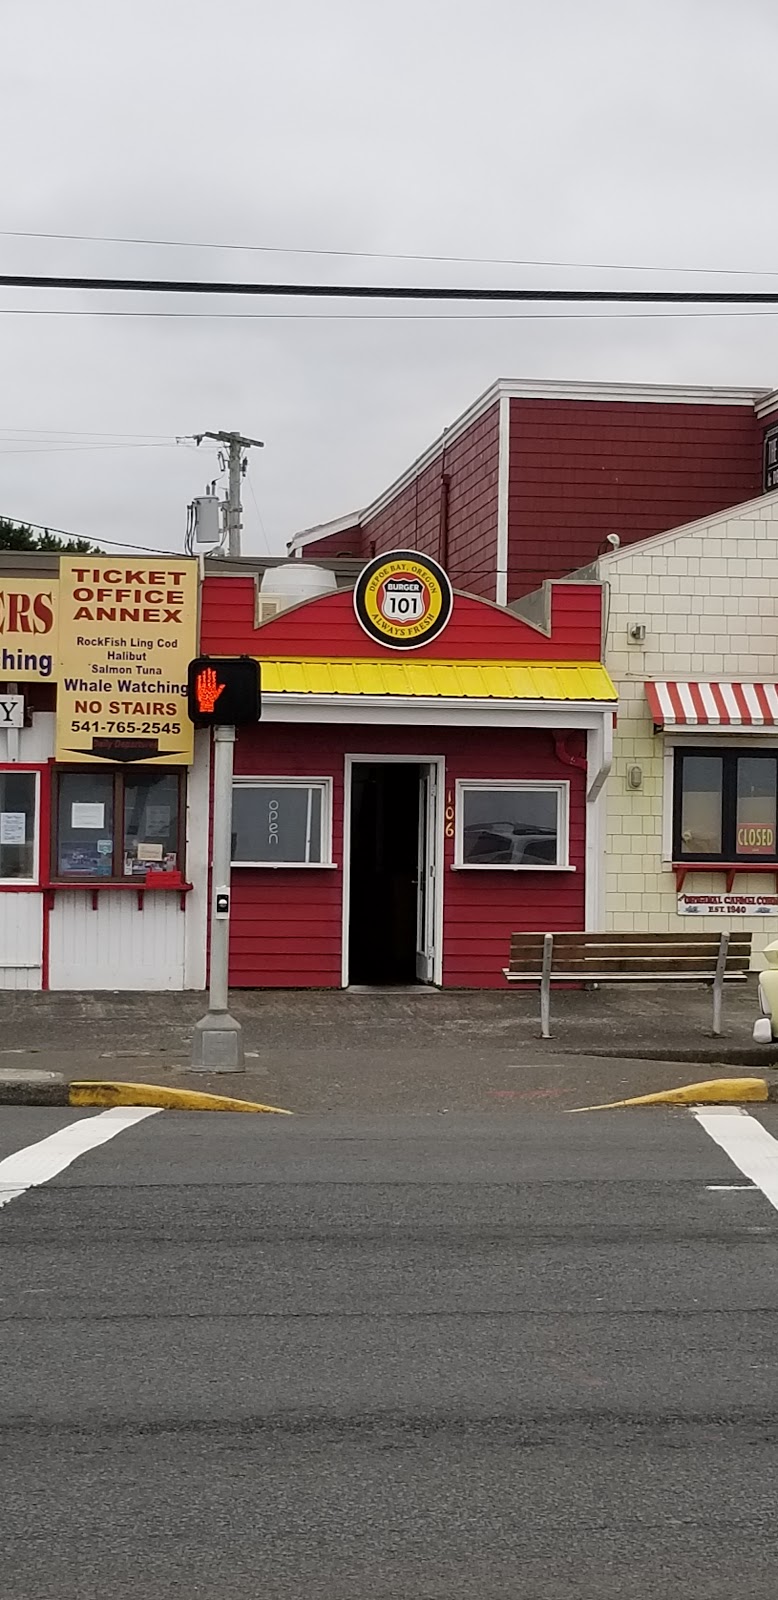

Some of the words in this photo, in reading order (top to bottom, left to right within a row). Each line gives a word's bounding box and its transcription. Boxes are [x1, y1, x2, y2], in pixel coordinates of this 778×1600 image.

[71, 568, 187, 586] TICKET
[369, 569, 390, 592] DEPOE
[411, 566, 438, 594] OREGON
[72, 587, 184, 605] OFFICE
[387, 583, 420, 591] BURGER
[389, 597, 417, 613] 101
[73, 606, 183, 624] ANNEX
[371, 613, 406, 636] ALWAYS
[408, 613, 435, 635] FRESH
[76, 636, 127, 648] RockFish
[130, 638, 154, 650] Ling
[157, 638, 178, 649] Cod
[107, 651, 147, 661] Halibut
[91, 664, 132, 675] Salmon
[136, 665, 162, 675] Tuna
[64, 678, 112, 692] Whale
[118, 680, 188, 697] Watching
[75, 700, 102, 714] NO
[109, 701, 177, 715] STAIRS
[71, 721, 181, 734] 541-765-2545
[268, 799, 279, 844] open
[445, 790, 454, 837] 106
[738, 828, 773, 846] CLOSED
[727, 905, 747, 914] 1940
